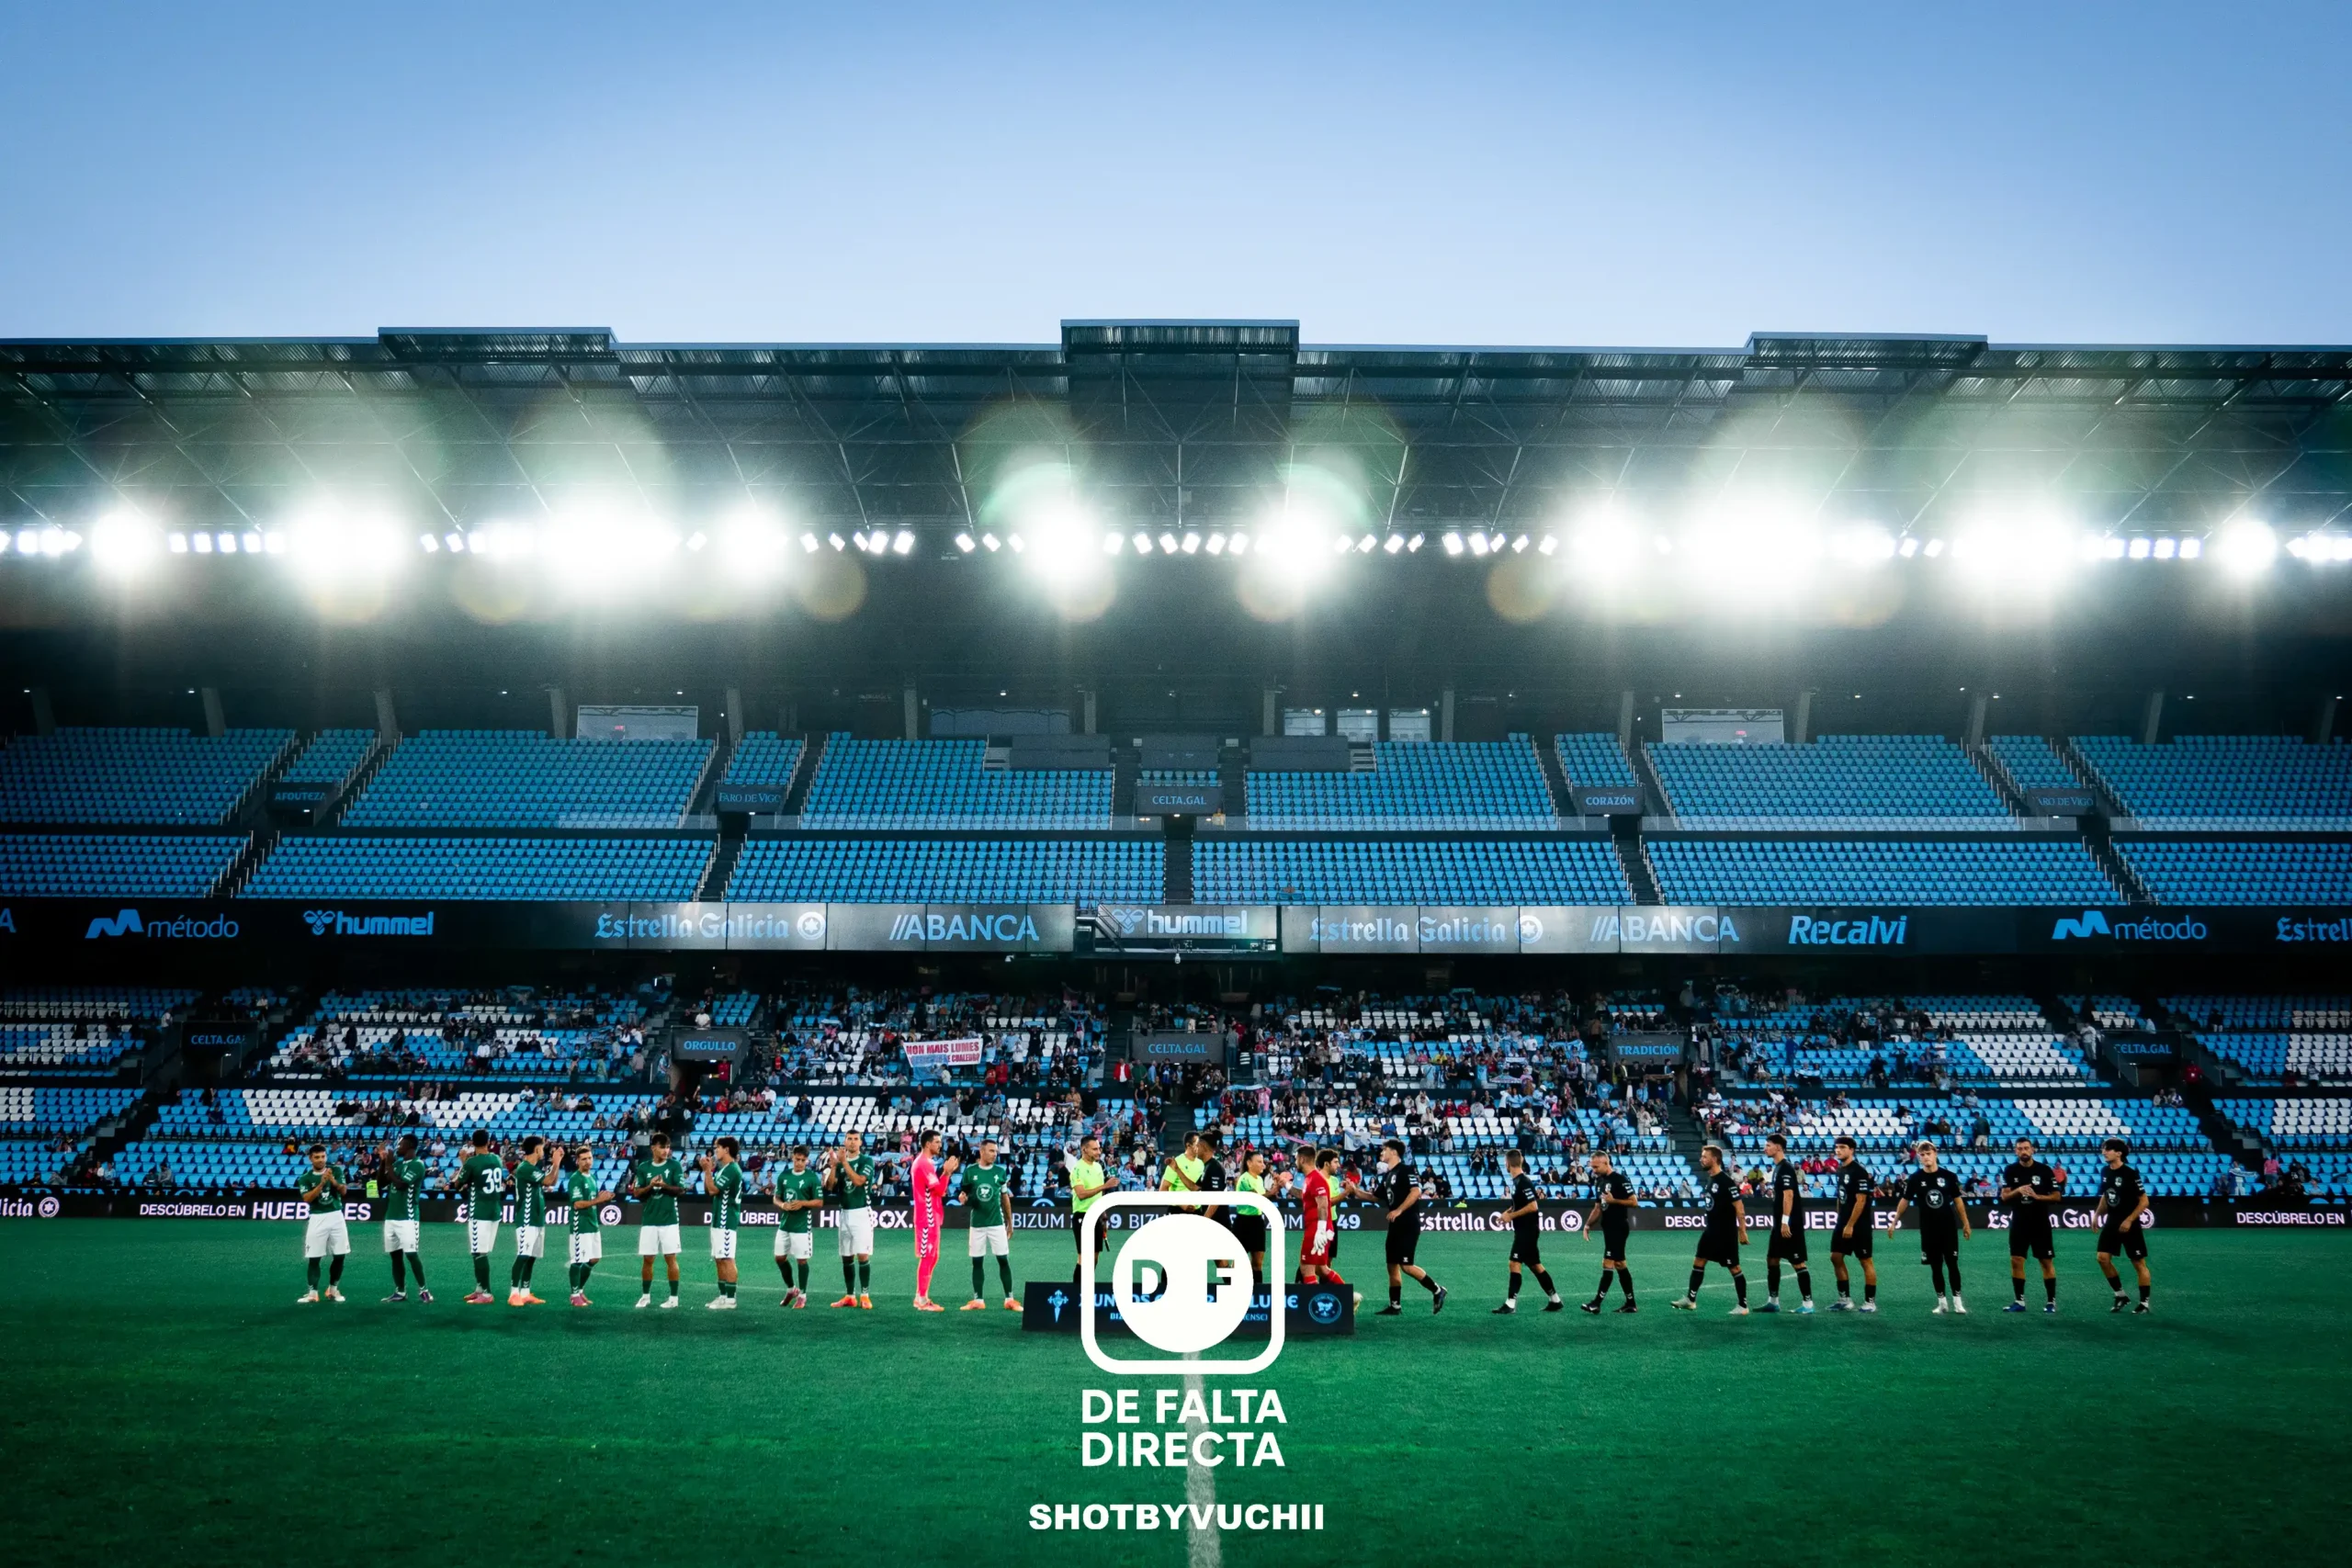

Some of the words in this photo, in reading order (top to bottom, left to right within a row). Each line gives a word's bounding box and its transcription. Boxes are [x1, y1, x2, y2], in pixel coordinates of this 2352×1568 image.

[744, 794, 758, 803] DE
[1152, 795, 1207, 805] CELTA.GAL
[1585, 794, 1634, 806] CORAZÓN
[147, 913, 239, 939] método
[336, 910, 435, 936] hummel
[594, 911, 694, 941] Estrella
[698, 911, 790, 941] Galicia
[1147, 908, 1249, 935] hummel
[2114, 914, 2208, 940] método
[1309, 915, 1409, 943] Estrella
[1415, 916, 1507, 944] Galicia
[1787, 915, 1909, 945] Recalvi
[684, 1040, 736, 1051] ORGULLO
[906, 1044, 924, 1055] NON
[926, 1043, 949, 1055] MAIS
[1148, 1043, 1207, 1054] CELTA.GAL
[1617, 1043, 1679, 1055] TRADICIÓN
[481, 1168, 502, 1194] 39
[140, 1202, 227, 1216] DESCÚBRELO
[228, 1204, 246, 1217] EN
[1012, 1213, 1065, 1229] BIZUM
[2236, 1211, 2325, 1224] DESCÚBRELO
[2326, 1213, 2346, 1224] EN
